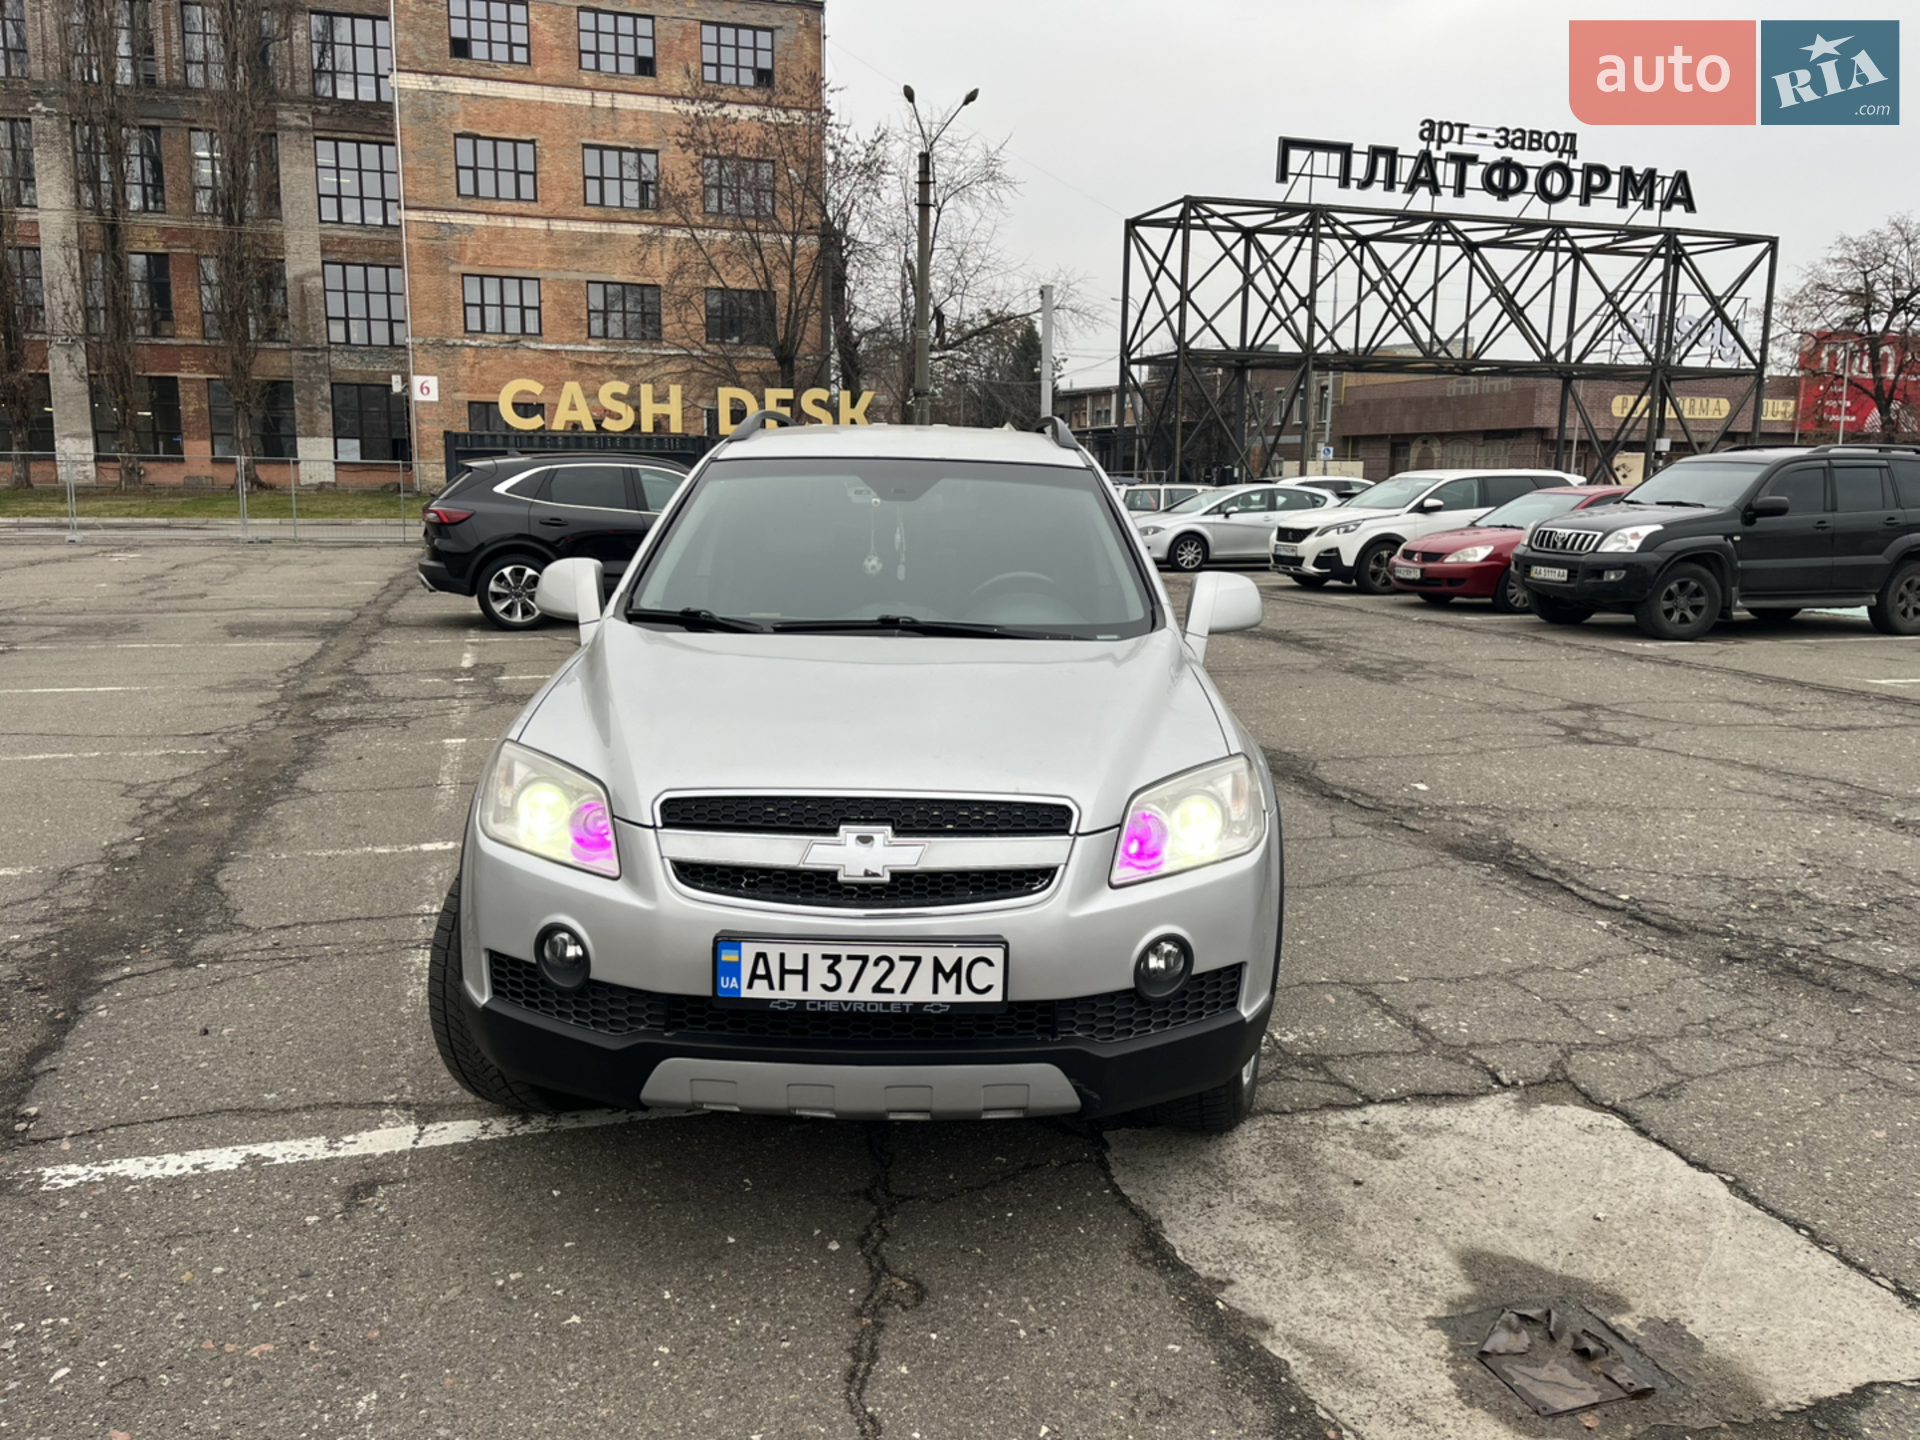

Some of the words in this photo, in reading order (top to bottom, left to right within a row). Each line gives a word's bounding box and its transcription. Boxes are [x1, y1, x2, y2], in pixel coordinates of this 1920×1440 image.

[1276, 136, 1697, 213] ПЛАТФОРМА
[419, 380, 431, 396] 6
[498, 378, 683, 434] CASH
[721, 976, 739, 989] UA
[746, 951, 809, 992] AH
[820, 953, 922, 994] 3727
[932, 955, 996, 996] MC
[806, 1000, 914, 1013] CHEVROLET
